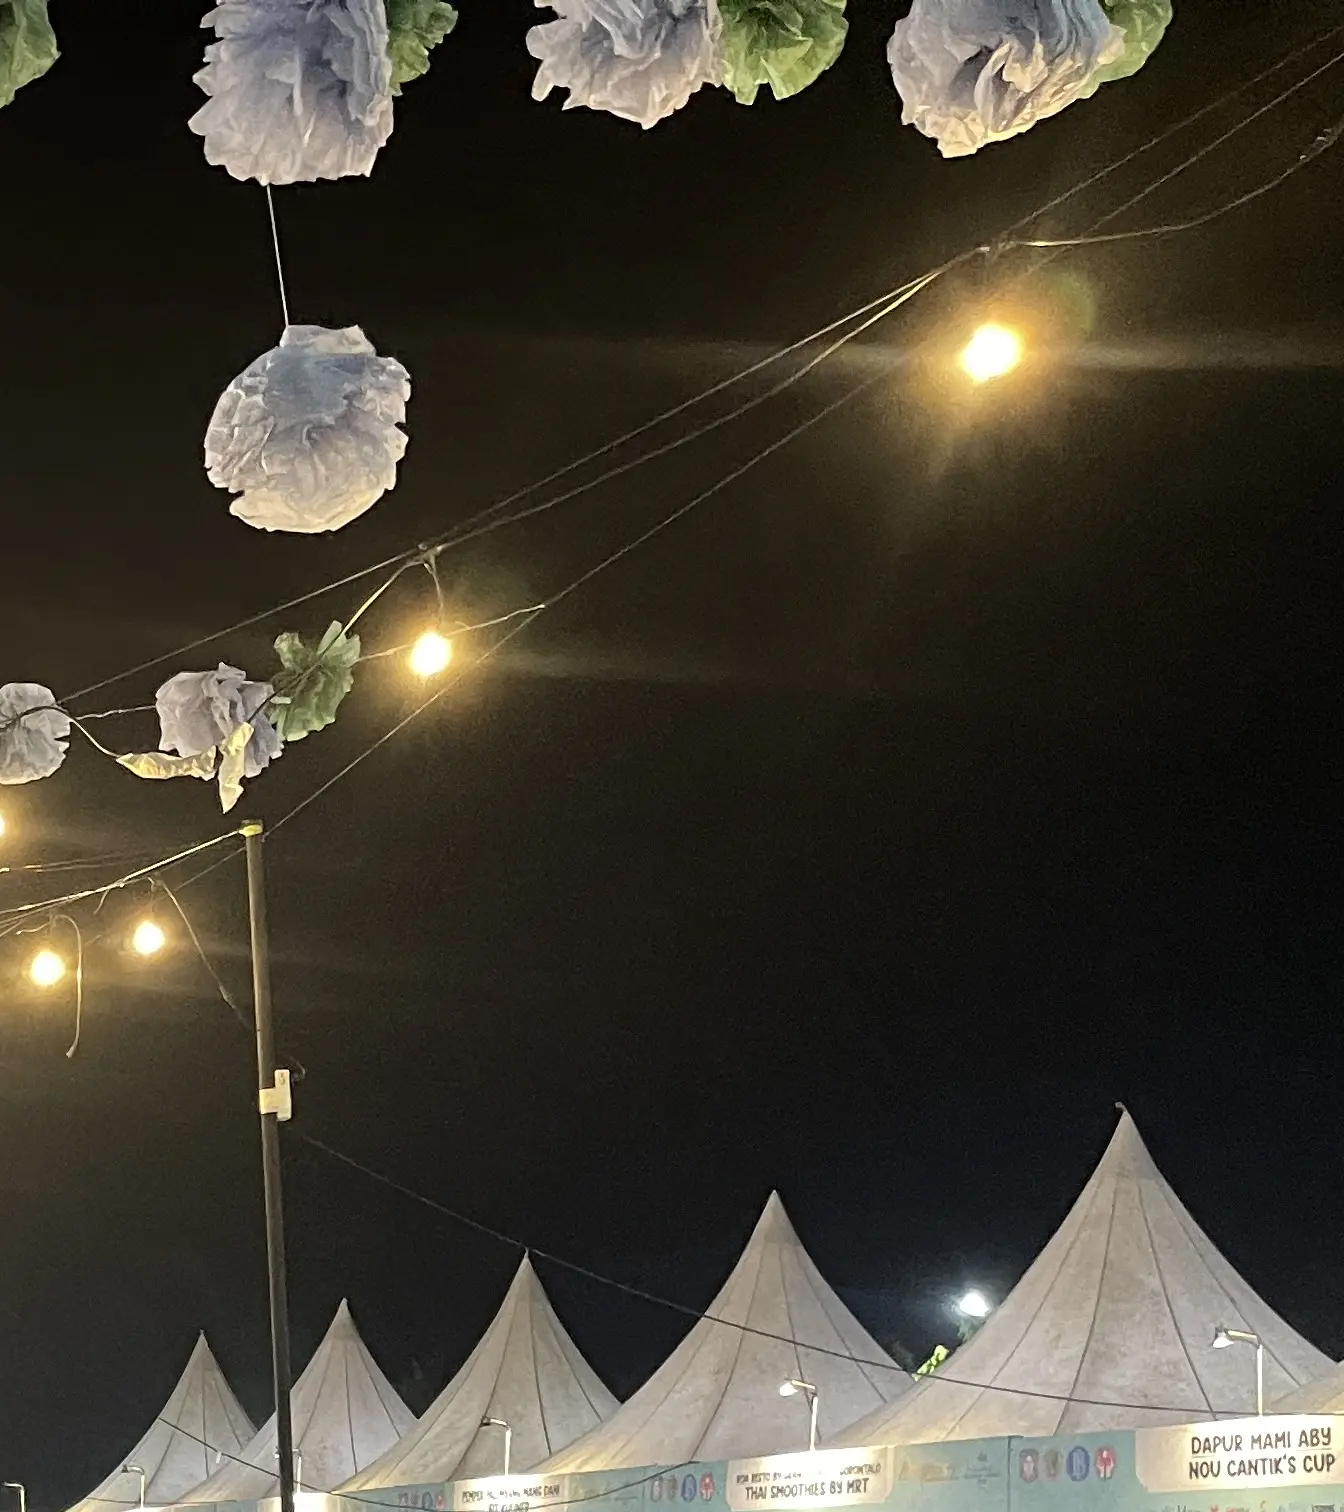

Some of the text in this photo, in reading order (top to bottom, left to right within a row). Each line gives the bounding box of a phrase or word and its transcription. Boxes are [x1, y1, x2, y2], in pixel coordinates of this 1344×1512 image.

[1191, 1427, 1332, 1455] DAPUR MAMI ABY
[1189, 1453, 1336, 1480] NOU CANTIK'S CUP
[745, 1486, 767, 1500] THAI
[771, 1483, 826, 1499] SMOOTHIES
[829, 1481, 843, 1494] BY
